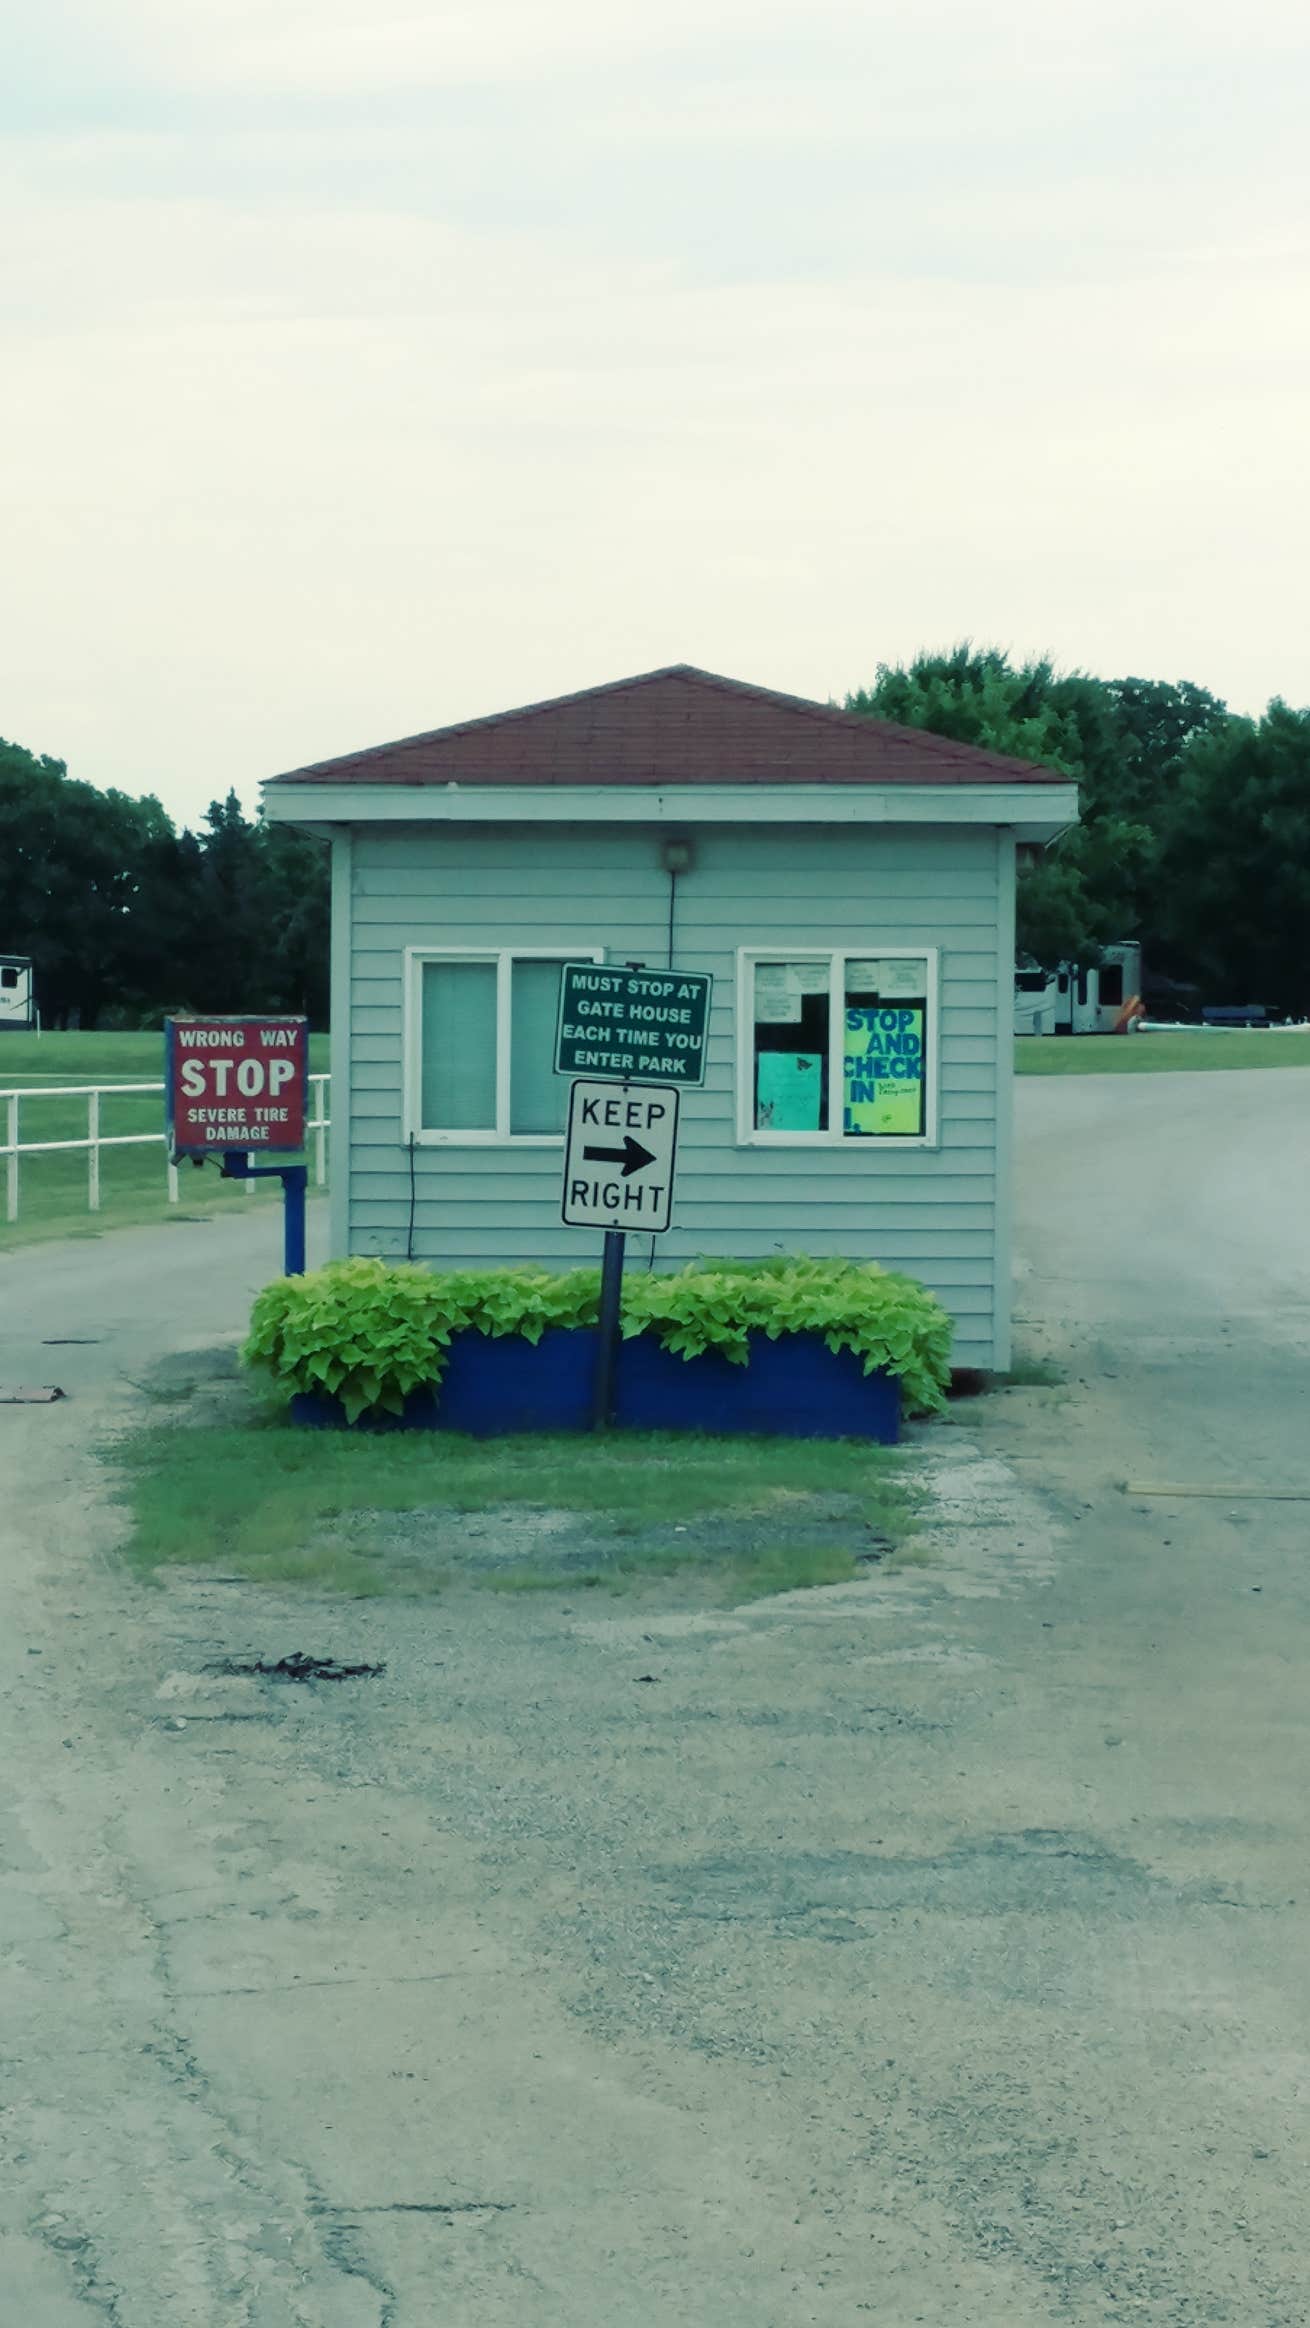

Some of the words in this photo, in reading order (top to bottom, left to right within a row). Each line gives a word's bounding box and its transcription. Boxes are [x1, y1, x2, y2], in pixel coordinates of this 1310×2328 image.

[572, 975, 624, 993] MUST
[627, 979, 675, 996] STOP
[677, 984, 701, 1000] AT
[577, 1000, 625, 1018] GATE
[629, 1005, 692, 1024] HOUSE
[847, 1008, 915, 1032] STOP
[179, 1030, 245, 1047] WRONG
[260, 1030, 298, 1047] WAY
[562, 1025, 611, 1043] EACH
[616, 1029, 660, 1046] TIME
[665, 1033, 702, 1050] YOU
[866, 1033, 920, 1055] AND
[574, 1051, 634, 1069] ENTER
[638, 1056, 687, 1074] PARK
[844, 1057, 921, 1079] CHECK
[180, 1059, 295, 1097] STOP
[851, 1080, 875, 1103] IN
[187, 1108, 247, 1123] SEVERE
[254, 1107, 289, 1122] TIRE
[581, 1098, 666, 1129] KEEP
[206, 1126, 270, 1141] DAMAGE
[570, 1180, 665, 1213] RIGHT
